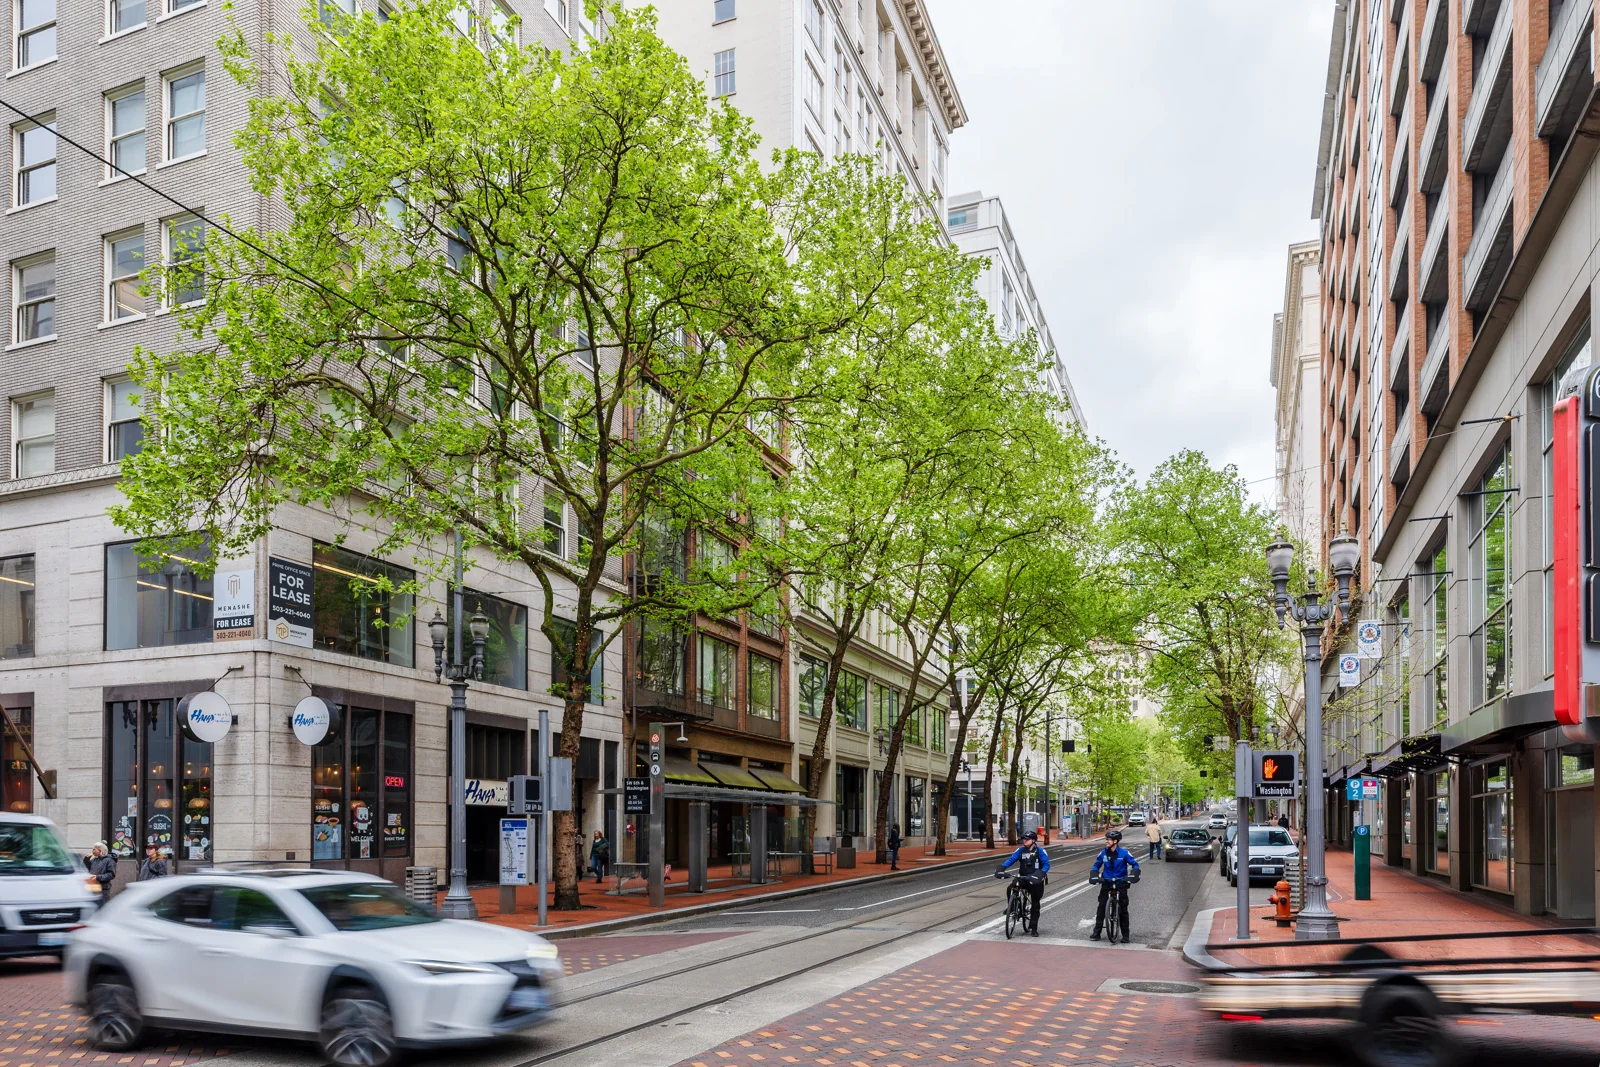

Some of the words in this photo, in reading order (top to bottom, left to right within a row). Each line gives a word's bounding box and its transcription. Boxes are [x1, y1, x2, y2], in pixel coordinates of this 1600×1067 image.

[271, 562, 284, 570] PRIME
[284, 566, 298, 574] OFFICE
[299, 569, 311, 577] SPACE
[279, 572, 304, 589] FOR
[272, 585, 311, 605] LEASE
[217, 603, 250, 611] MENASHE
[272, 605, 311, 619] 503-221-4040
[216, 619, 229, 628] FOR
[231, 617, 251, 627] LEASE
[216, 630, 252, 639] 503-221-4040
[385, 775, 404, 787] OPEN
[1259, 786, 1292, 797] Washington
[1352, 789, 1359, 797] 2
[153, 822, 167, 830] SUSHI
